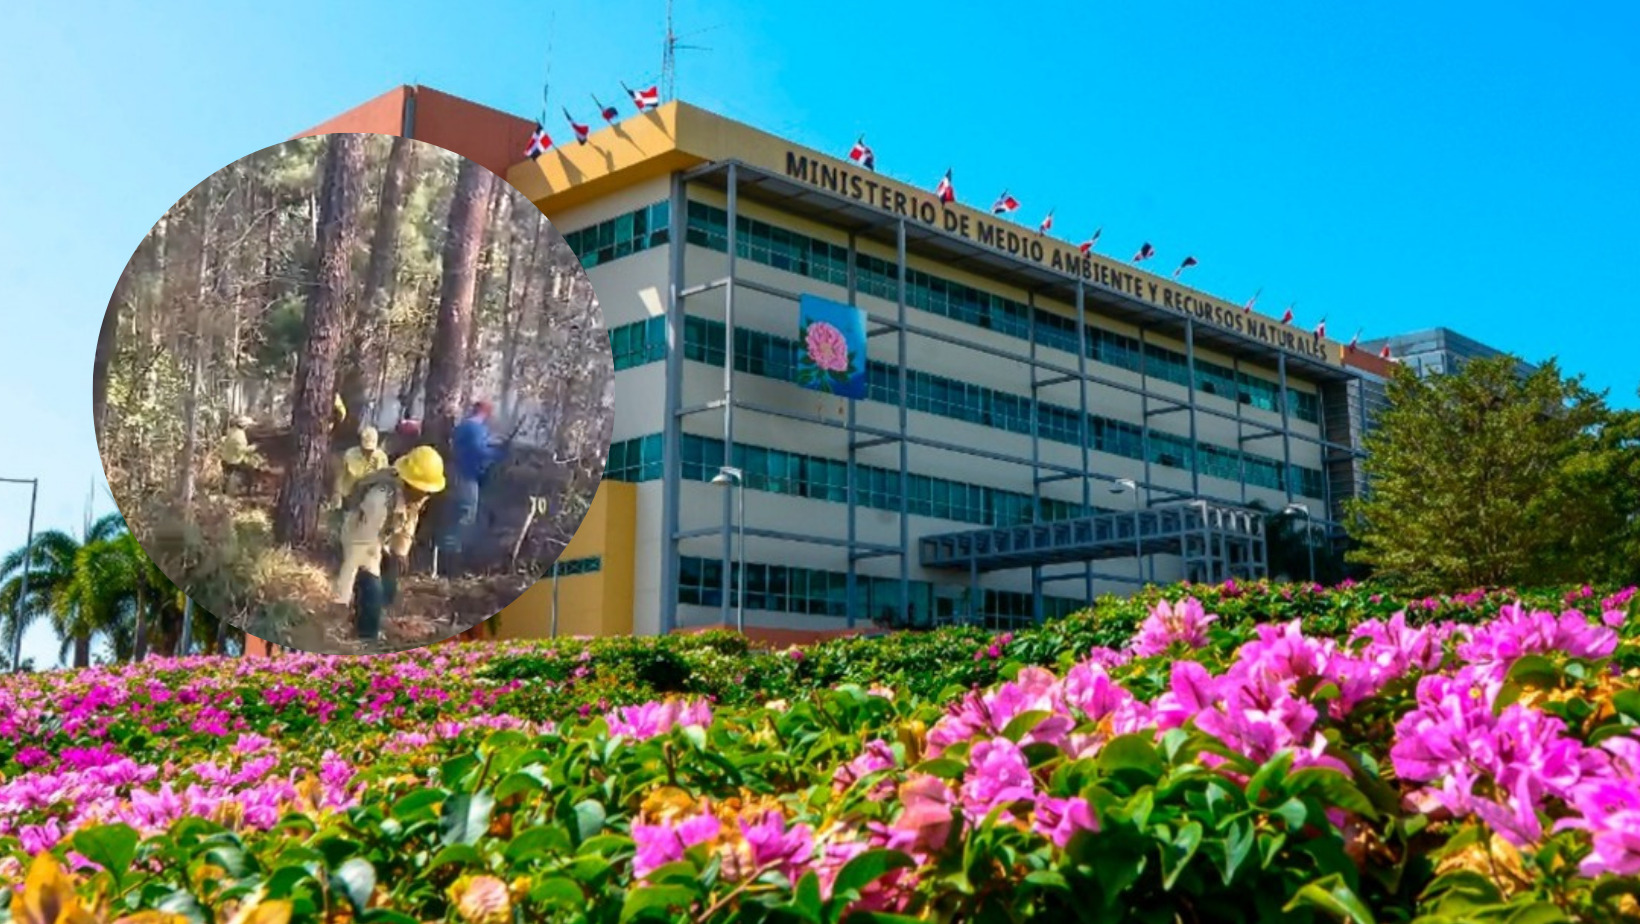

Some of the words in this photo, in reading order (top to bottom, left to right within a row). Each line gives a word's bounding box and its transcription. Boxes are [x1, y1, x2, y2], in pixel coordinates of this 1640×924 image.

[786, 152, 936, 225] MINISTERIO
[941, 207, 970, 238] DE
[977, 220, 1044, 262] MEDIO
[1051, 248, 1143, 297] AMBIENTE
[1148, 282, 1158, 301] Y
[1163, 287, 1243, 332] RECURSOS
[1247, 318, 1328, 361] NATURALES
